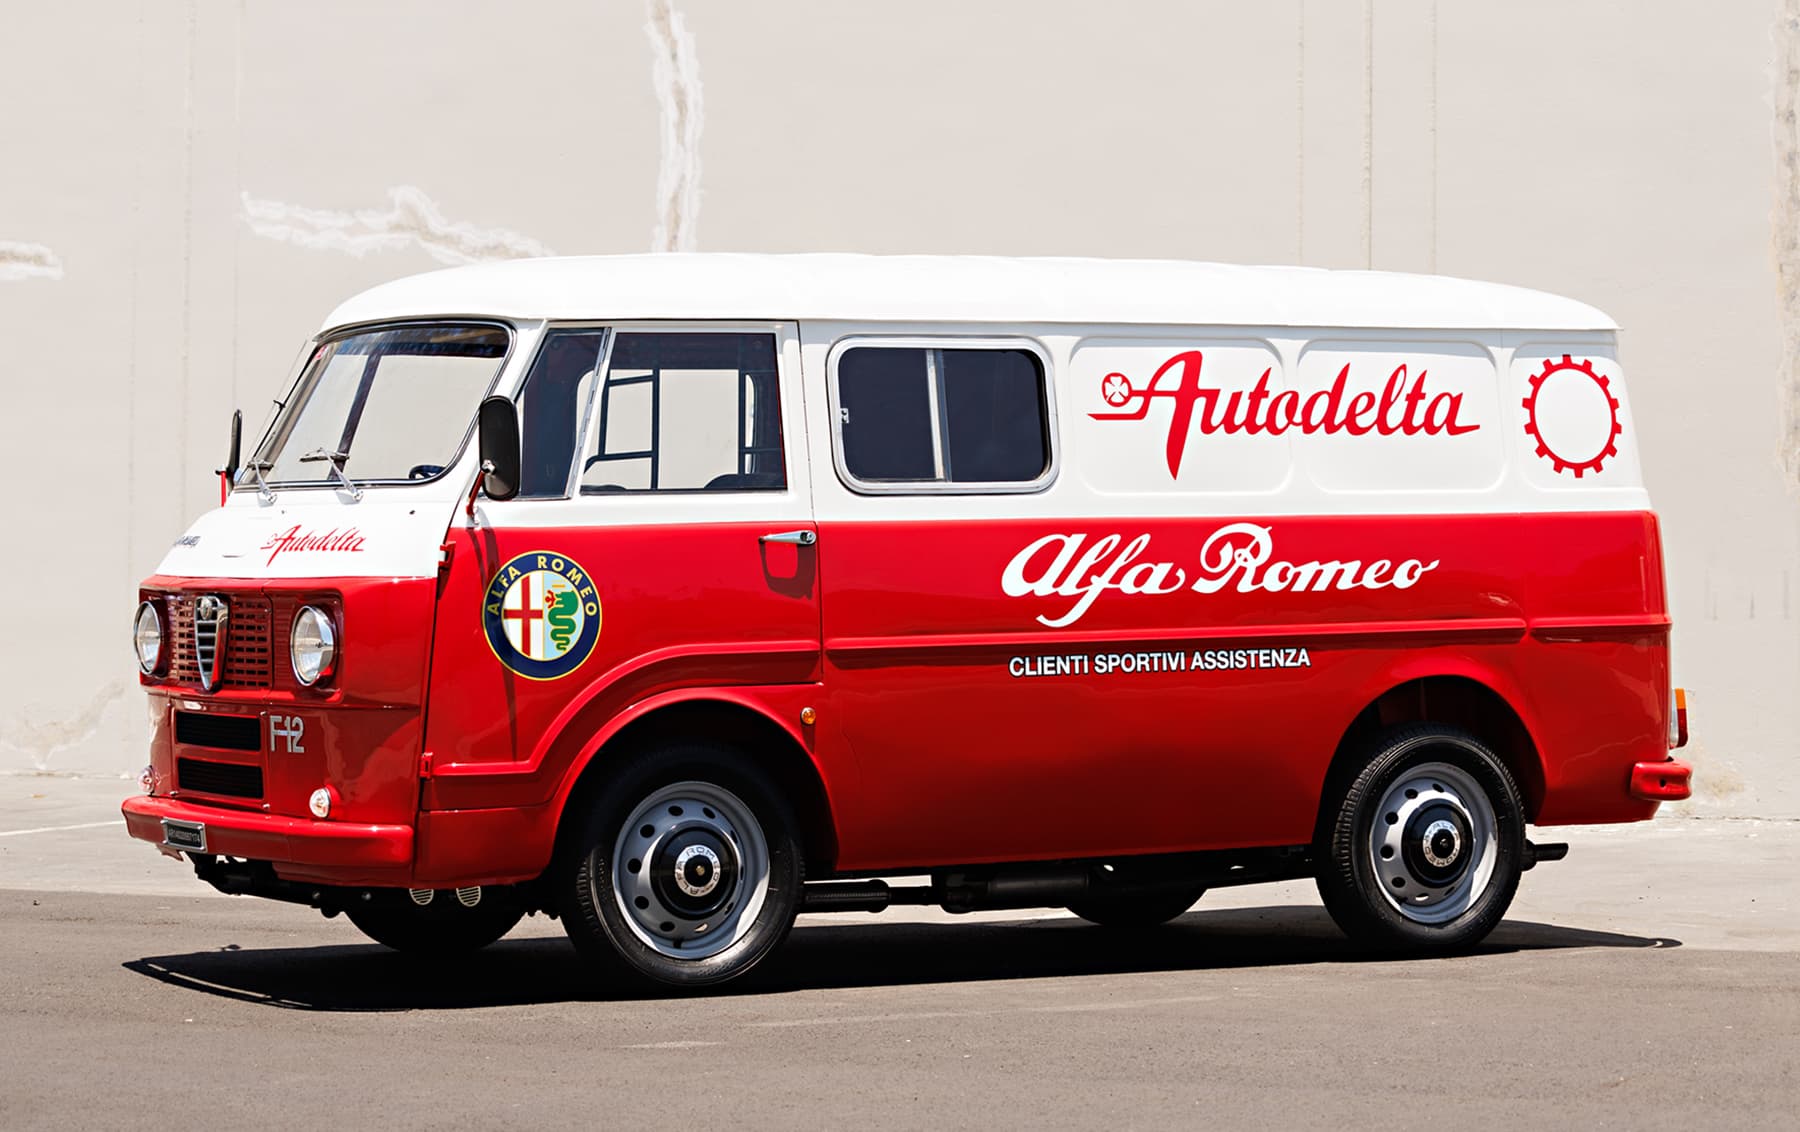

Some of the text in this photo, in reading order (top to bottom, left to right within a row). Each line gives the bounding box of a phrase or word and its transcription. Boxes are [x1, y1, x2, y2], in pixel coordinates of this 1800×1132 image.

[1088, 350, 1480, 480] Autodelta
[260, 524, 366, 567] Autodelta
[487, 555, 598, 617] ALFA ROMEO
[1001, 522, 1440, 628] Alfa Romeo
[1009, 648, 1311, 677] CLIENTI SPORTIVI ASSISTENZA
[686, 846, 720, 881] ROMEO
